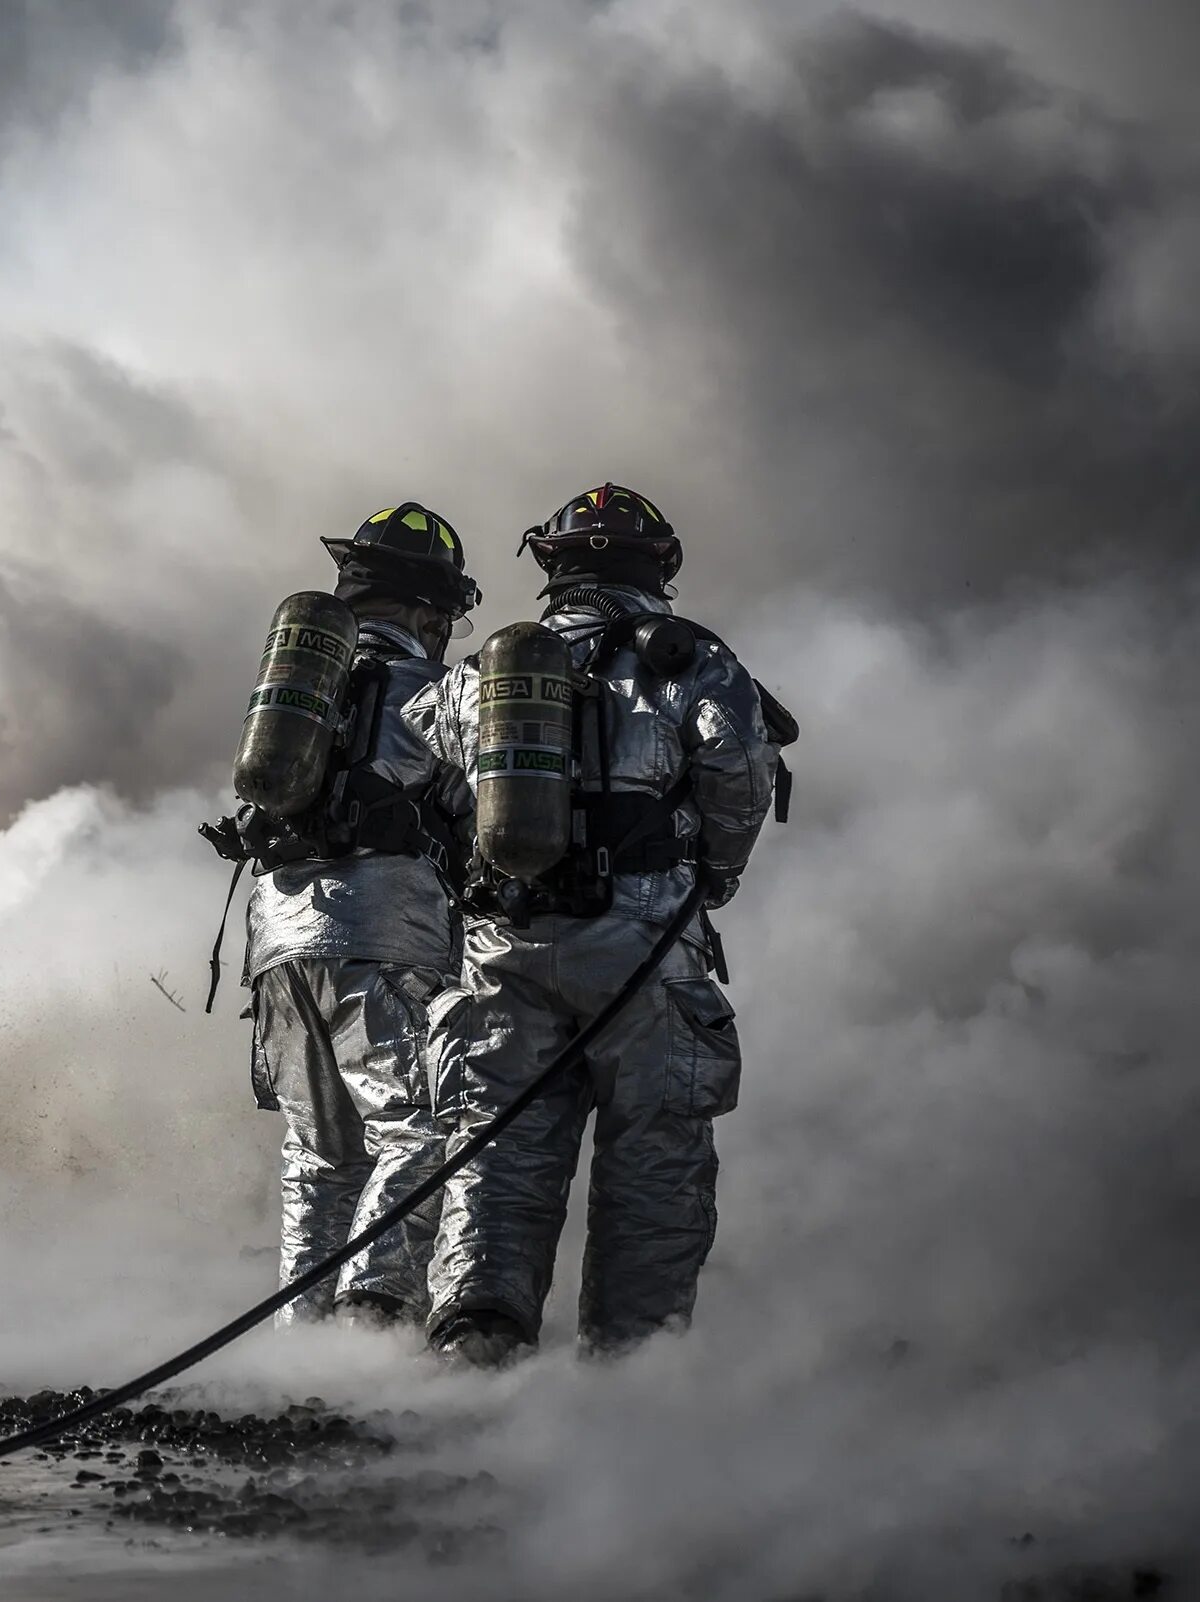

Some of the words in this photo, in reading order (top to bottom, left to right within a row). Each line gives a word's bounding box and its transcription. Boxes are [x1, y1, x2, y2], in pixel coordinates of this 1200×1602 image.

[265, 630, 287, 649] SA
[300, 631, 346, 662] MSA
[249, 689, 270, 707] SA
[279, 690, 326, 716] MSA
[482, 680, 528, 700] MSA
[545, 681, 571, 703] MS
[479, 751, 506, 771] SA
[516, 751, 563, 772] MSA
